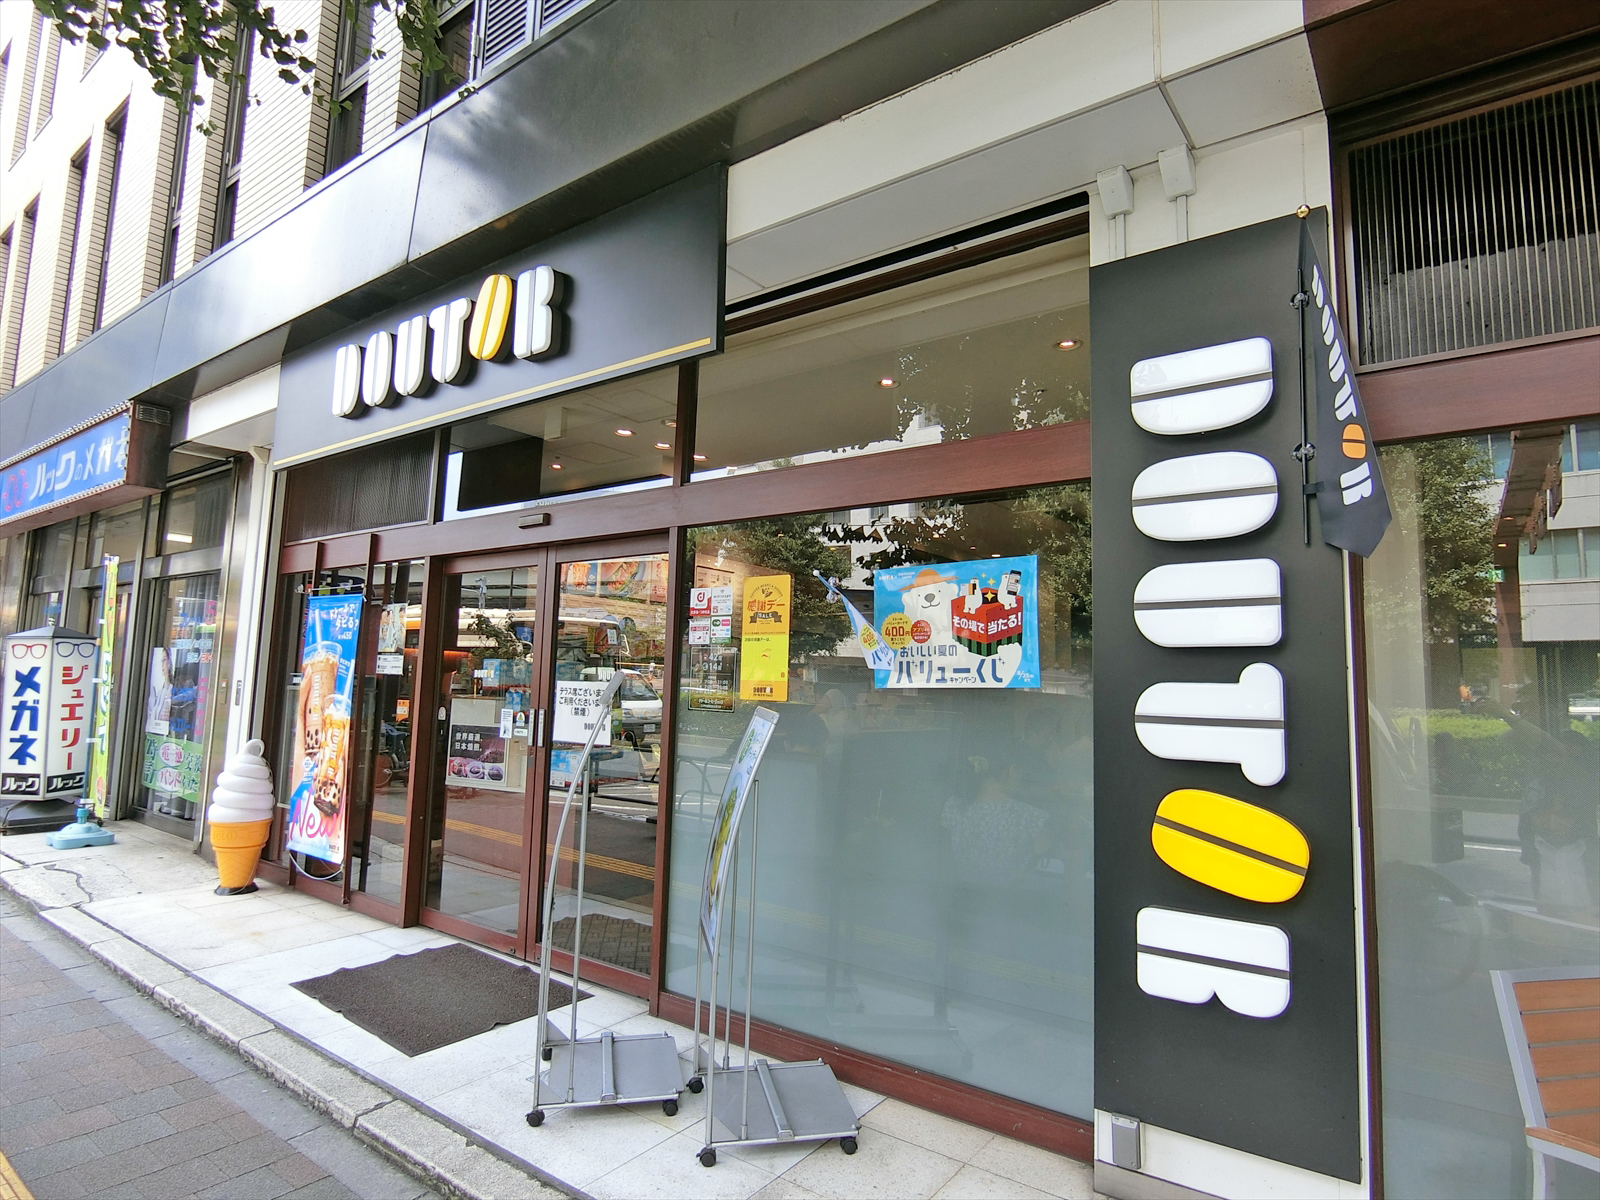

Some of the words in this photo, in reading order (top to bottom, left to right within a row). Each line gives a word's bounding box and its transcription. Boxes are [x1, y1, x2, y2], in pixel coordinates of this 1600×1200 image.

[331, 264, 563, 418] DOUTOR
[747, 598, 786, 612] 感謝デー
[885, 626, 911, 637] 400円
[952, 615, 985, 634] その場で
[987, 612, 1022, 635] 当たる!
[900, 644, 958, 658] おいしい夏の
[896, 656, 1006, 684] バリューくじ
[949, 676, 977, 684] キャンペーン
[1129, 335, 1311, 1019] DOUTOR
[558, 697, 601, 707] ご利用くださいま
[8, 666, 42, 766] メガネ
[60, 664, 89, 771] ジュエリー
[2, 776, 40, 792] ルック
[48, 774, 85, 791] ルック
[290, 787, 343, 841] New!
